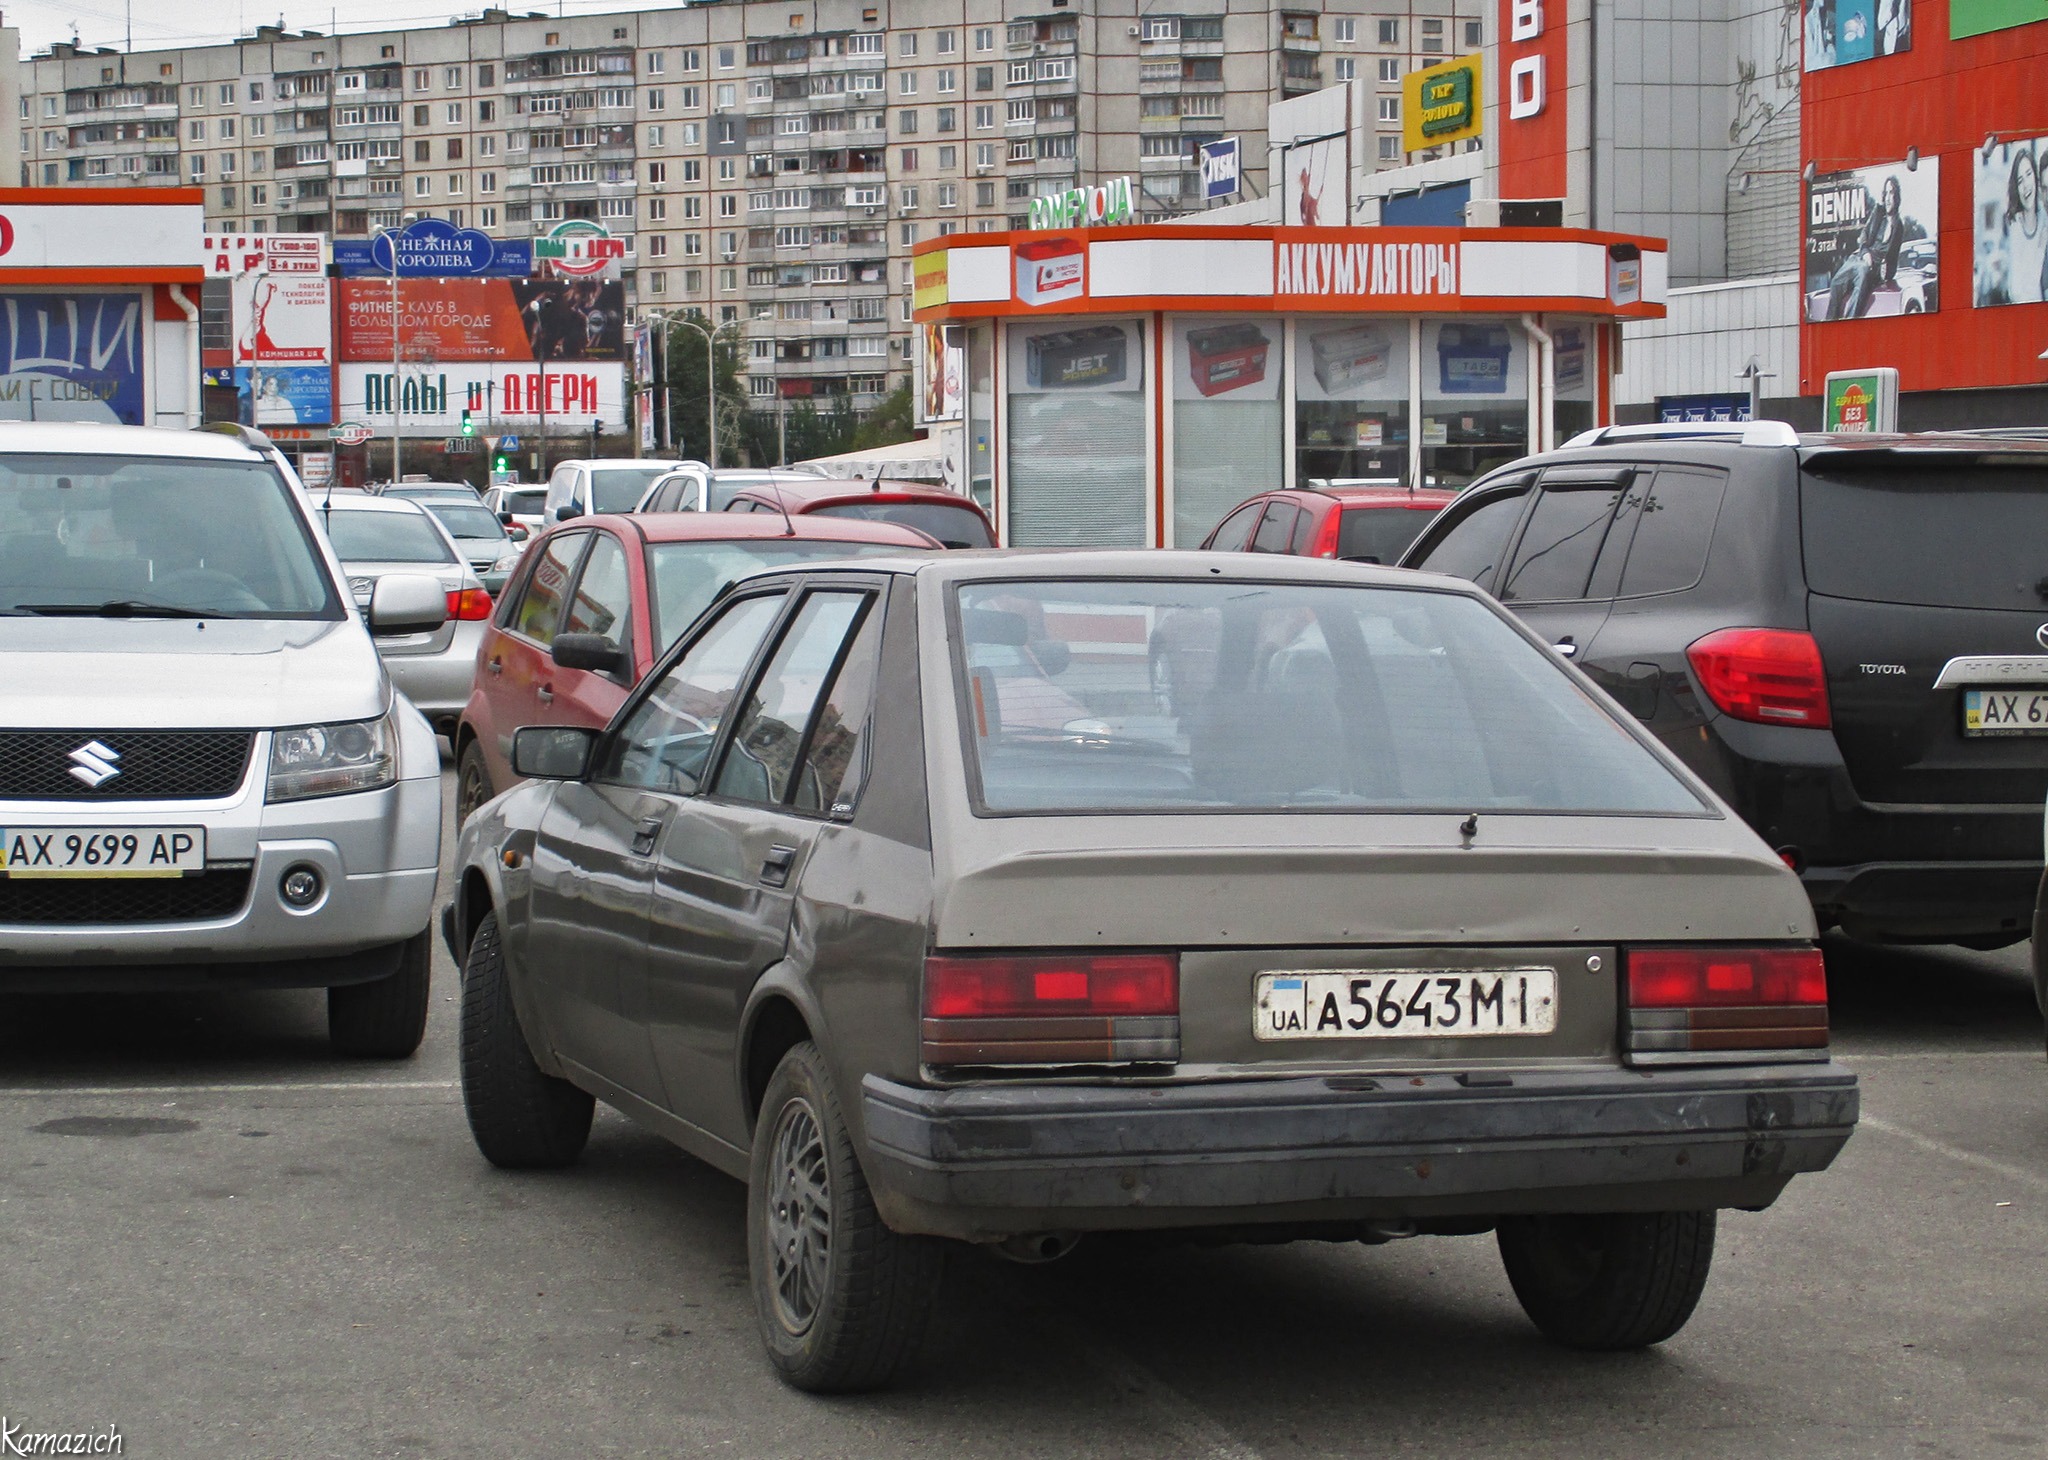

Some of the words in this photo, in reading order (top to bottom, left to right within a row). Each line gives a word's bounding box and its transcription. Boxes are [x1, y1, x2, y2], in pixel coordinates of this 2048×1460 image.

[1811, 188, 1866, 225] DENIM
[397, 232, 473, 251] НЕЖНАЯ
[1277, 243, 1457, 296] АККУМУЛЯТОРЫ
[349, 301, 404, 313] ФИТНЕС
[408, 301, 444, 313] КЛУБ
[448, 301, 457, 313] В
[349, 314, 429, 327] БОЛЬШОМ
[433, 314, 492, 327] ГОРОДЕ
[1063, 354, 1108, 373] JET
[365, 373, 447, 415] ПОЛЫ
[500, 373, 598, 415] ДВЕРИ
[1845, 407, 1862, 421] БЕЗ
[1859, 664, 1906, 675] TOYOTA
[1968, 716, 1980, 724] UA
[1984, 696, 2019, 723] AX
[9, 834, 53, 865] AX
[65, 834, 138, 865] 9699
[149, 833, 193, 864] AP
[1272, 1010, 1301, 1031] UA
